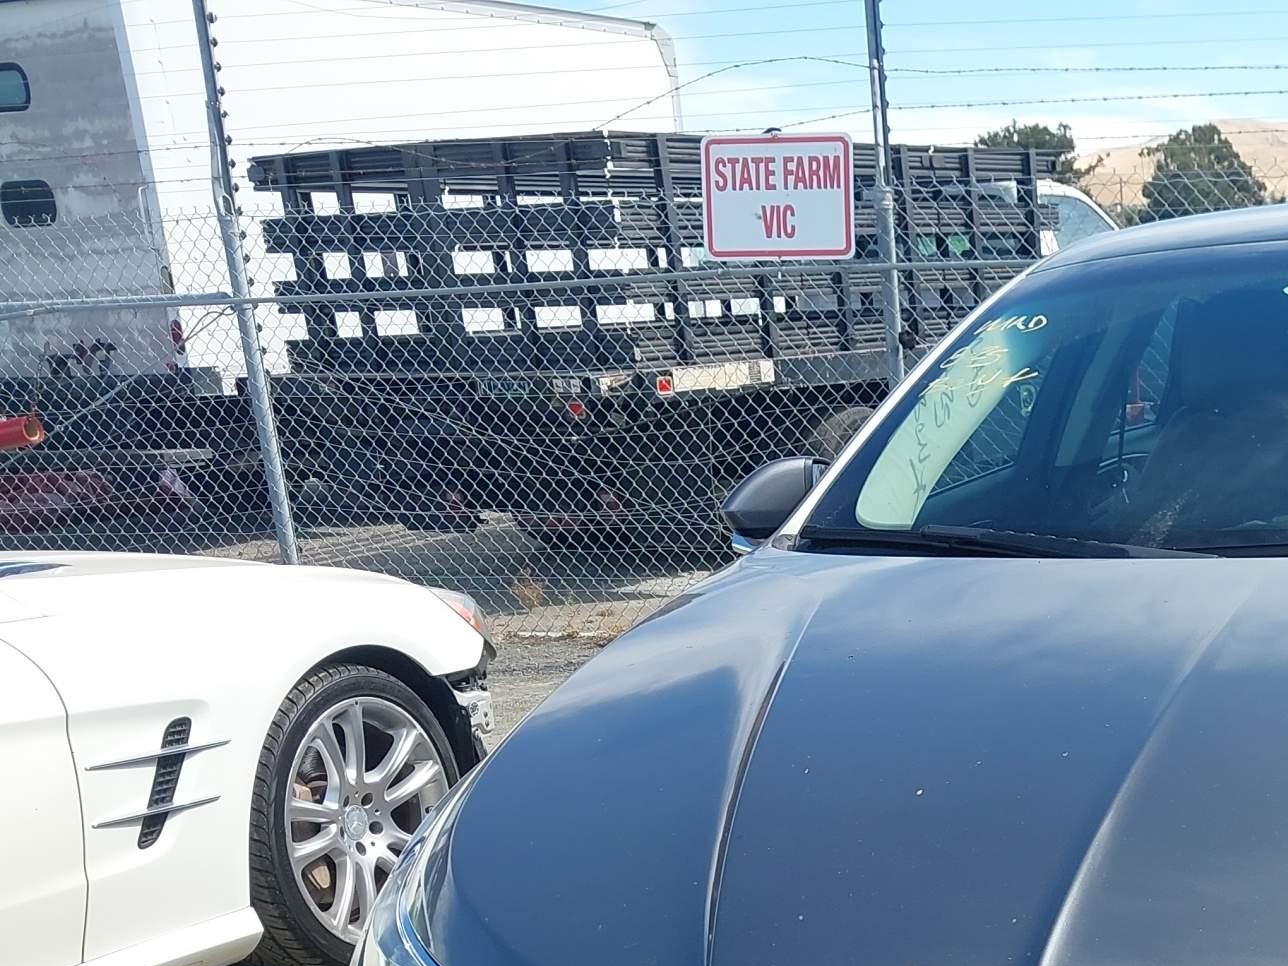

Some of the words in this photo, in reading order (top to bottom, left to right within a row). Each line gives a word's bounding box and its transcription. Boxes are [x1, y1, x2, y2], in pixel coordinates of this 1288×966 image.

[714, 156, 777, 192] STATE
[783, 154, 841, 191] FARM
[761, 204, 796, 239] VIC
